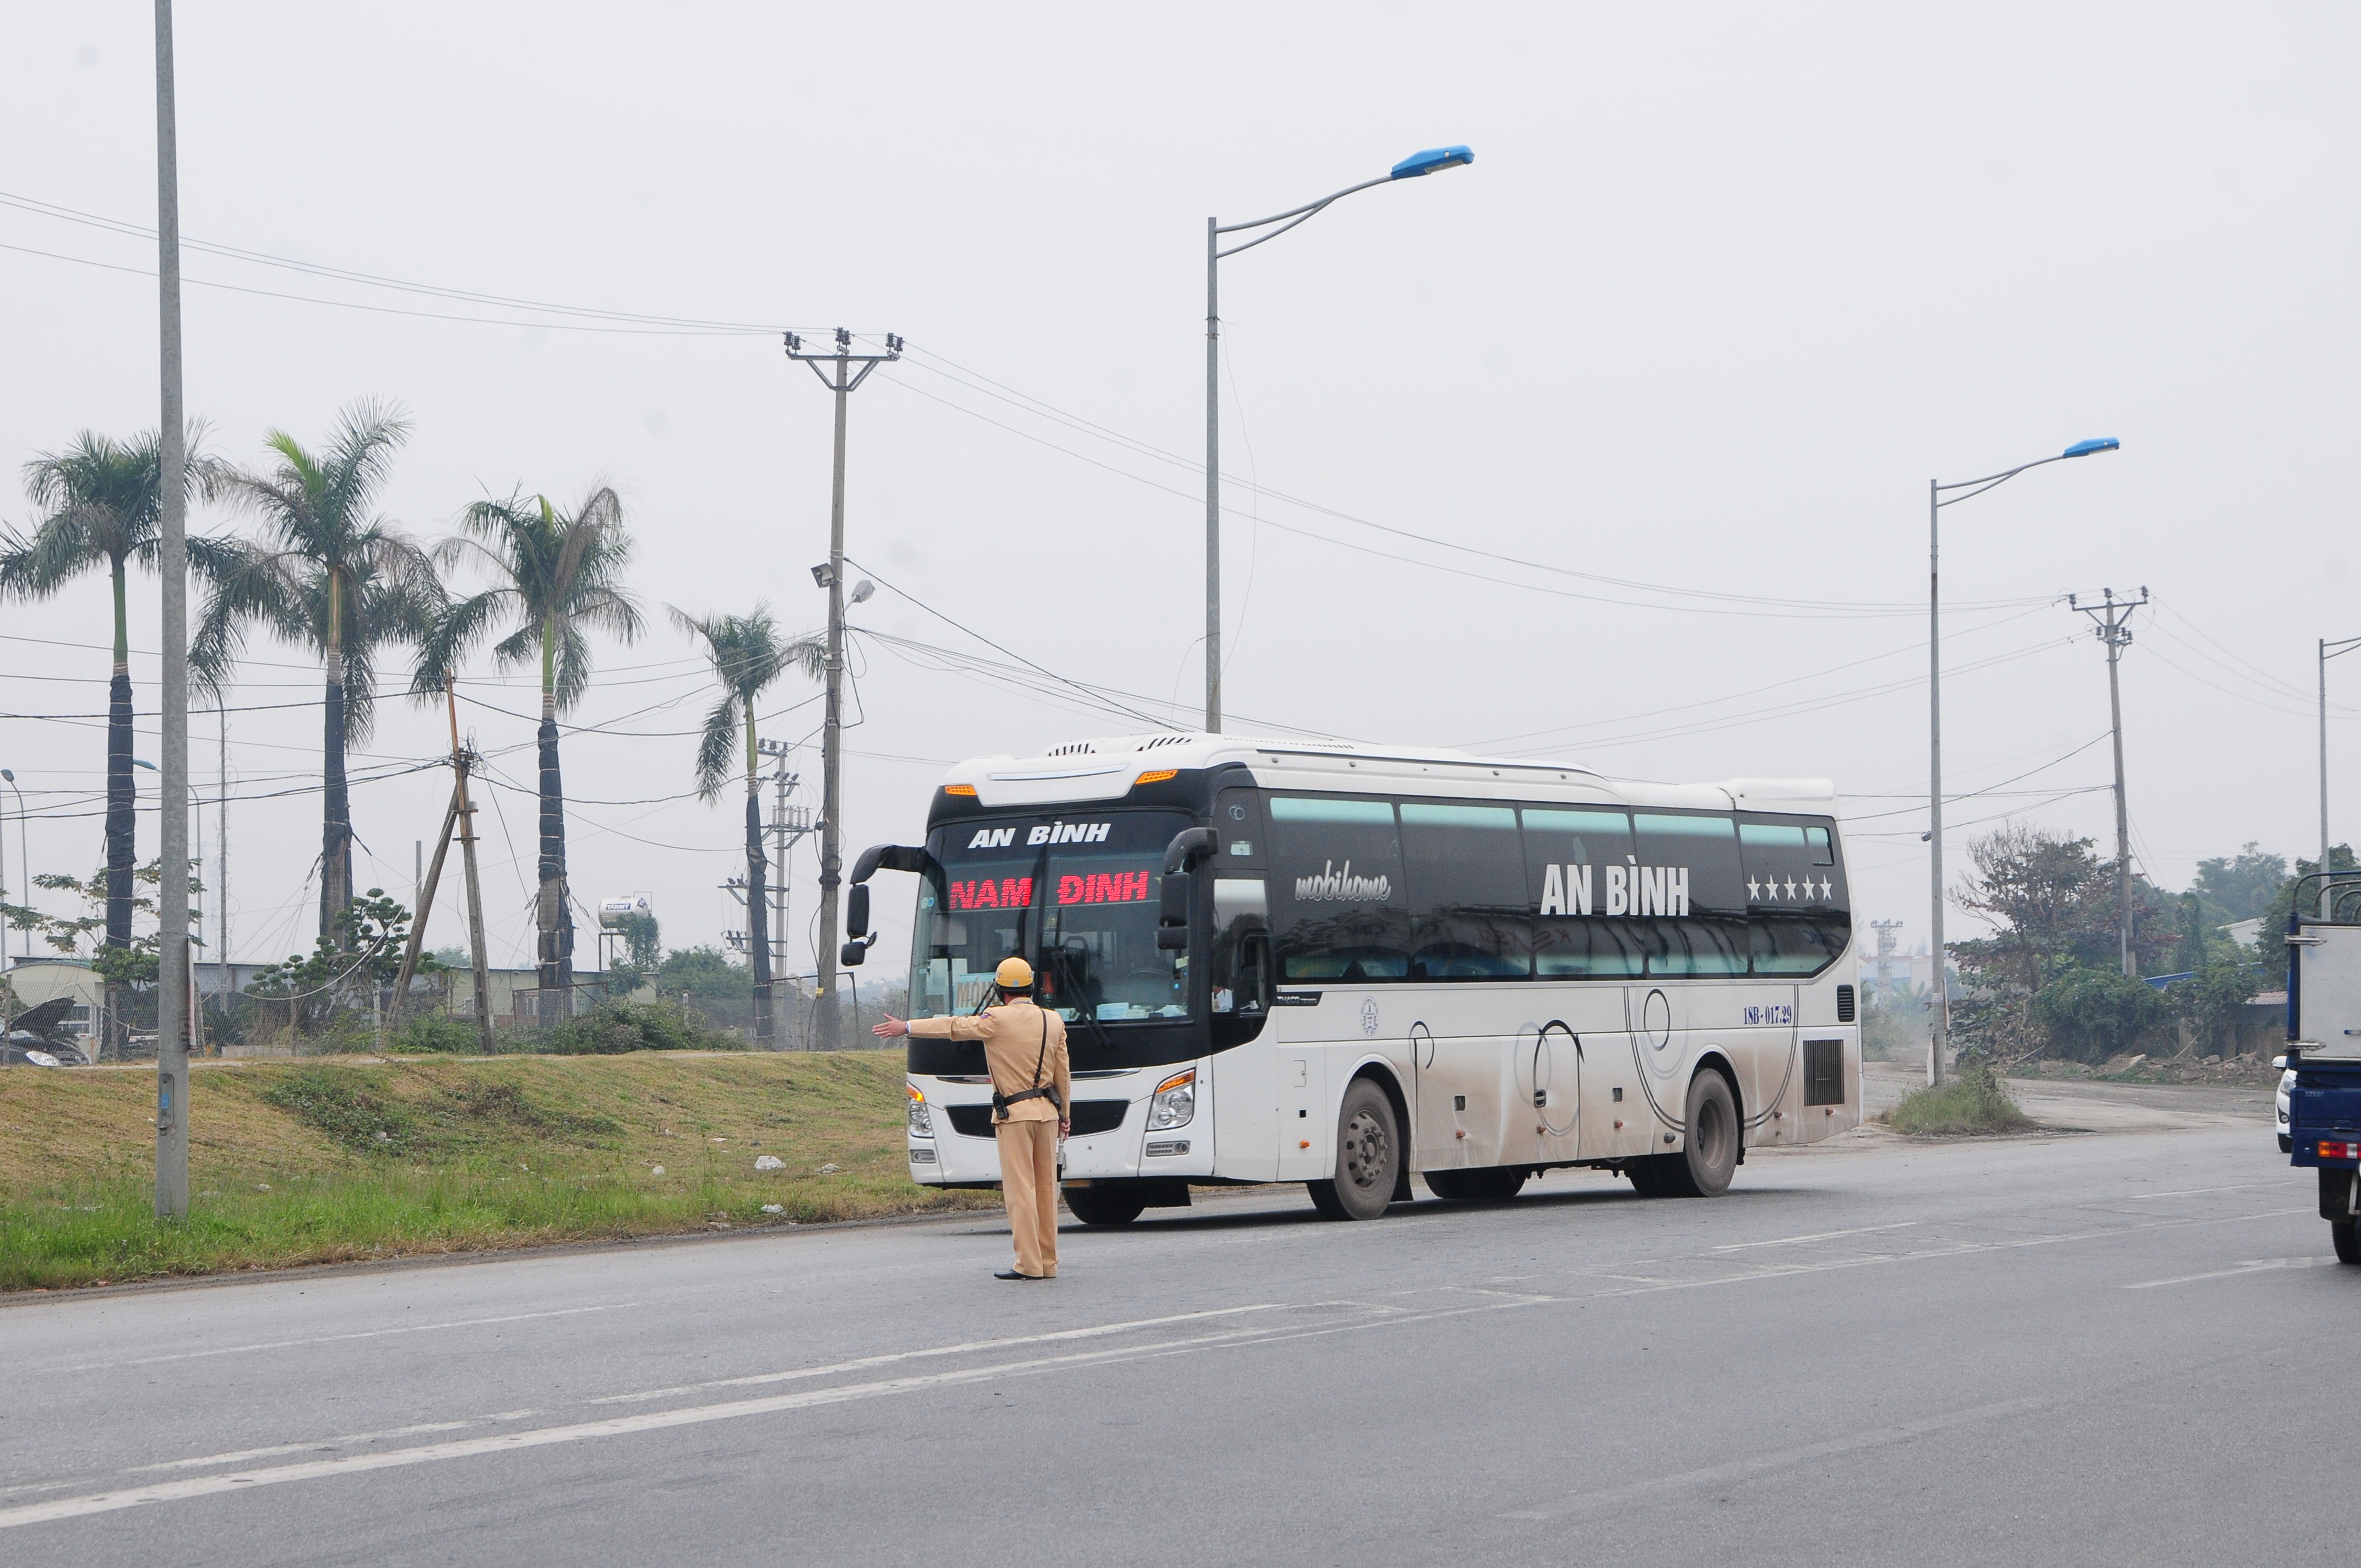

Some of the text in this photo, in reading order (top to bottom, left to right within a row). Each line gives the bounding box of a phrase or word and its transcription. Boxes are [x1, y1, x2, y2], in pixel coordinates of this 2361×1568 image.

[967, 821, 1112, 848] AN BÌNH
[950, 877, 1032, 909] NAM
[1295, 859, 1391, 901] mobihome
[1539, 854, 1689, 916] AN BÌNH
